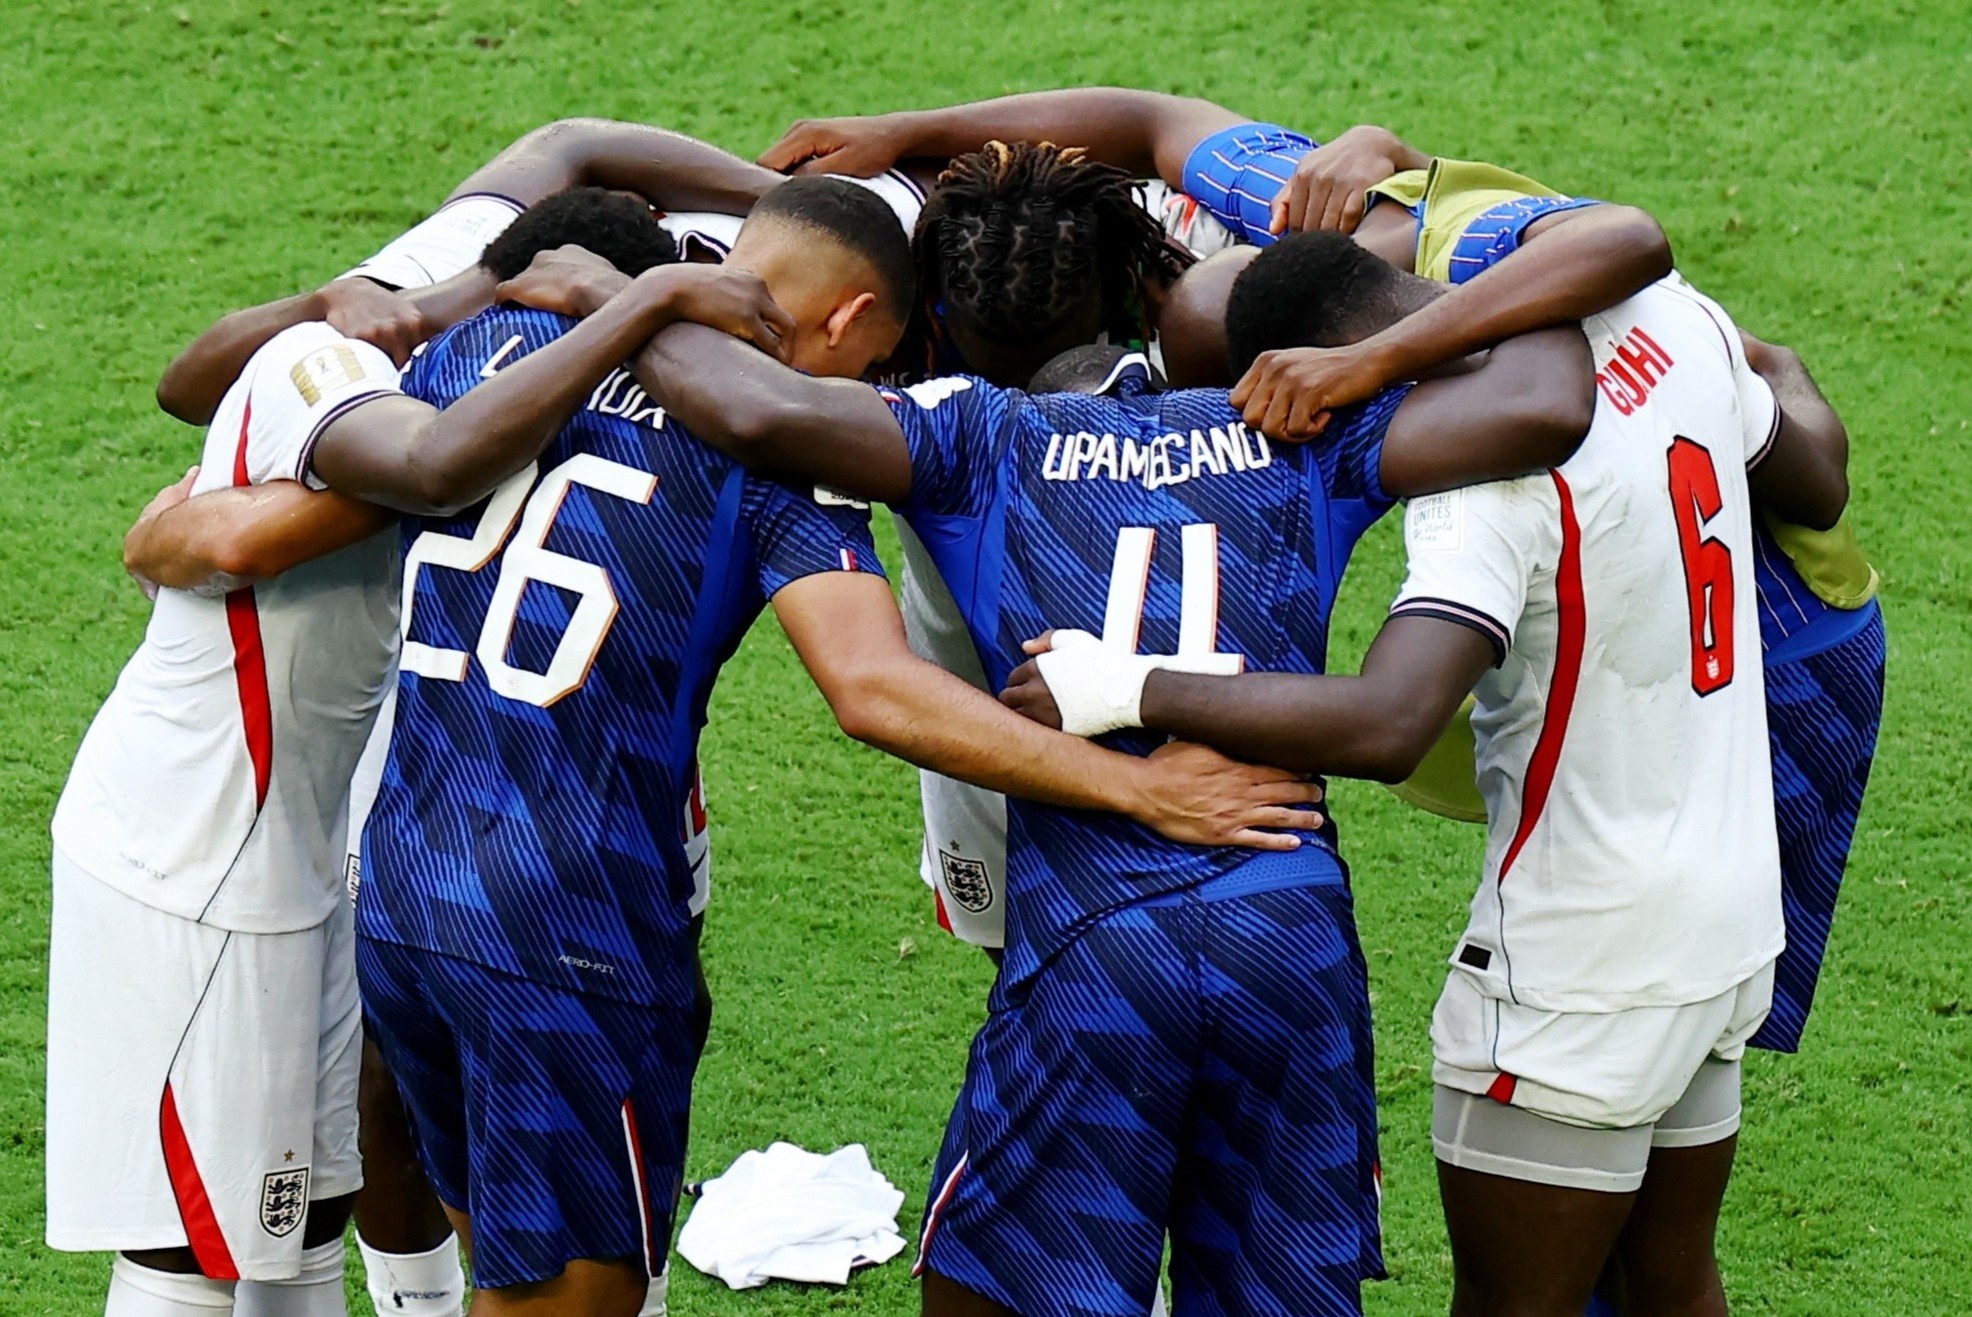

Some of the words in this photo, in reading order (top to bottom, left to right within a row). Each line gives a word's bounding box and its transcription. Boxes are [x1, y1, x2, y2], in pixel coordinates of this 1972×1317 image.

[1041, 421, 1272, 491] UPAMECANO
[1413, 504, 1451, 526] UNITES
[400, 452, 659, 709] 26
[1667, 434, 1735, 698] 6
